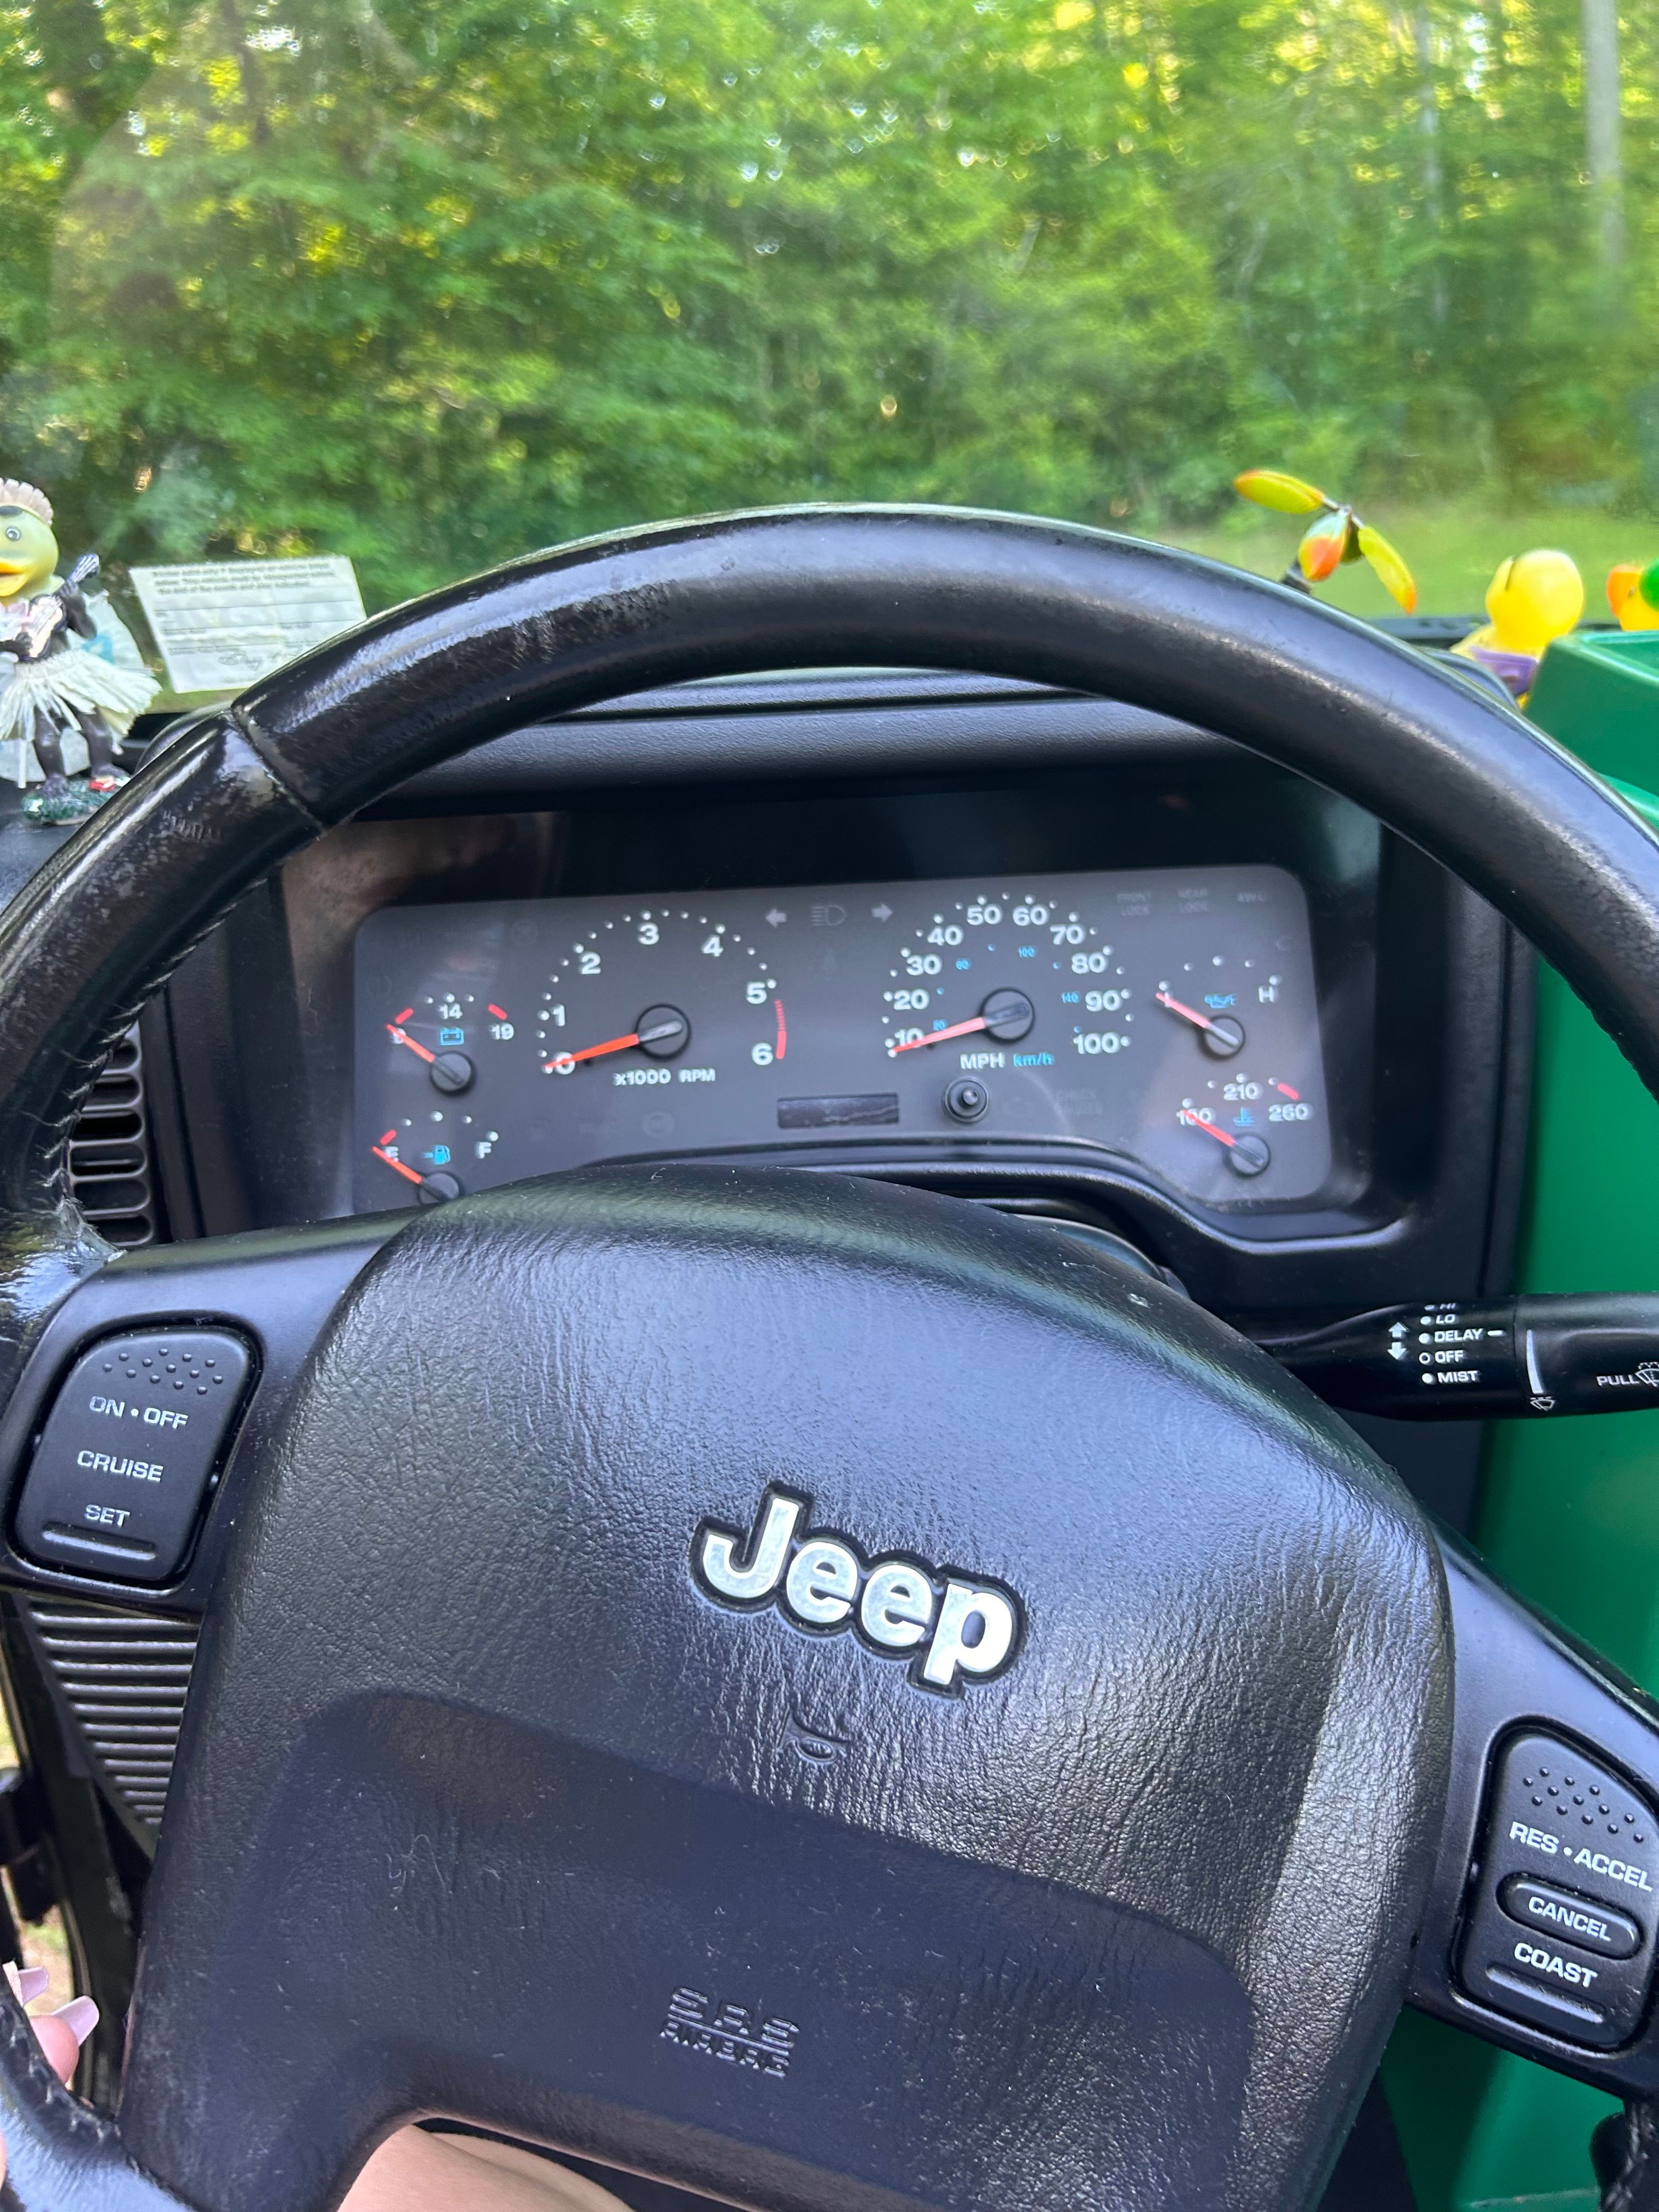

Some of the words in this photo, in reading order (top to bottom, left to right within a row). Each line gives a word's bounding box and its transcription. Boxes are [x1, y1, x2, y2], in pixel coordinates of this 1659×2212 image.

[967, 904, 1003, 926] 50
[1013, 904, 1050, 926] 60
[638, 922, 659, 945] 3
[927, 924, 964, 946] 40
[1049, 924, 1086, 945] 70
[702, 934, 724, 957] 4
[579, 951, 601, 974] 2
[906, 953, 943, 976] 30
[1071, 952, 1108, 974] 80
[746, 981, 767, 1004] 5
[893, 989, 929, 1010] 20
[1085, 990, 1122, 1012] 90
[1258, 985, 1278, 1003] H
[438, 1003, 463, 1019] 14
[551, 1003, 566, 1026] 1
[490, 1023, 515, 1040] 19
[894, 1028, 925, 1048] 10
[1073, 1031, 1122, 1054] 100
[554, 1052, 575, 1075] 0
[751, 1043, 773, 1065] 6
[960, 1052, 1006, 1069] MPH
[1013, 1052, 1055, 1067] km/h
[678, 1068, 715, 1083] RPM
[1223, 1082, 1263, 1101] 210
[1268, 1103, 1314, 1121] 260
[476, 1141, 492, 1159] F
[1436, 1313, 1457, 1325] LO
[1434, 1328, 1483, 1342] DELAY
[1435, 1350, 1465, 1364] OFF
[1437, 1370, 1480, 1384] MIST
[1596, 1374, 1640, 1387] PULL
[89, 1396, 125, 1418] ON
[143, 1407, 189, 1429] OFF
[77, 1449, 164, 1482] CRUISE
[84, 1504, 131, 1527] SET
[702, 1497, 1013, 1686] Jeep
[1509, 1821, 1559, 1854] RES
[1573, 1847, 1653, 1892] ACCEL
[1528, 1896, 1612, 1942] CANCEL
[1514, 1942, 1598, 1989] COAST
